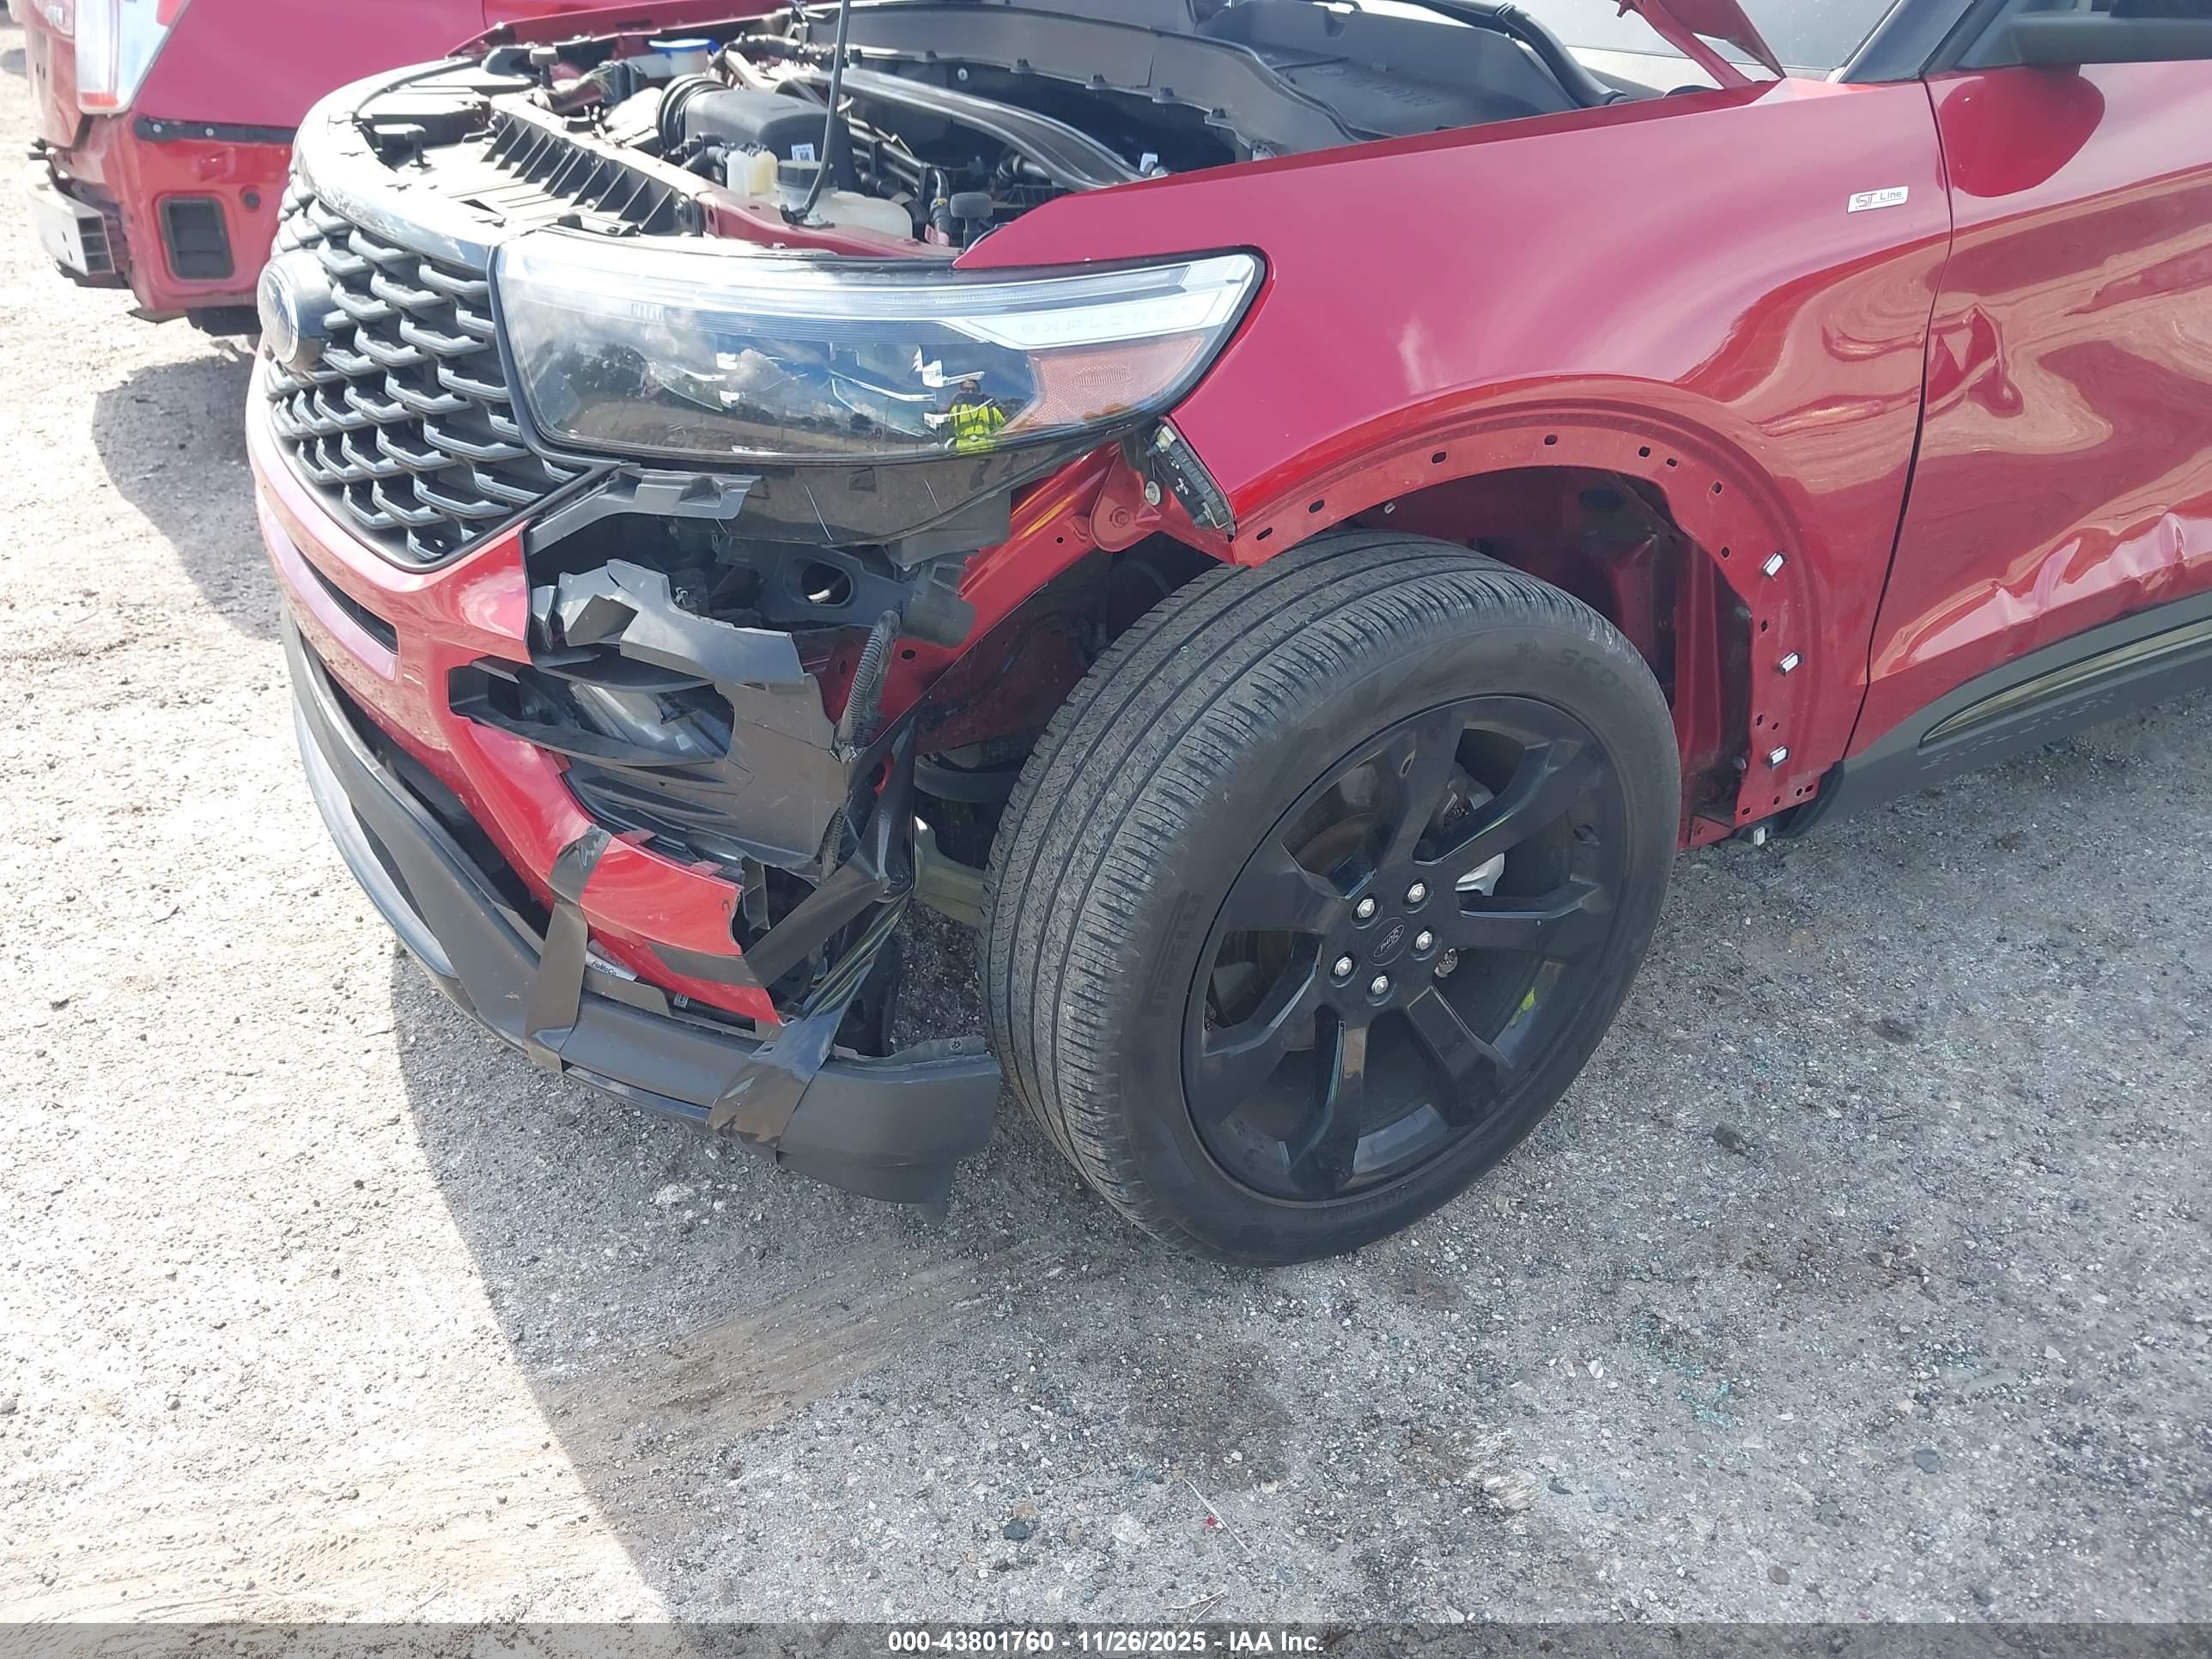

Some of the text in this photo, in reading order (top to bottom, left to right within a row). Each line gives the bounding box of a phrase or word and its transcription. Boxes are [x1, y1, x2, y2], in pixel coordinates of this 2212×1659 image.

[1855, 191, 1902, 209] ST Line
[591, 960, 617, 976] FoMoCo
